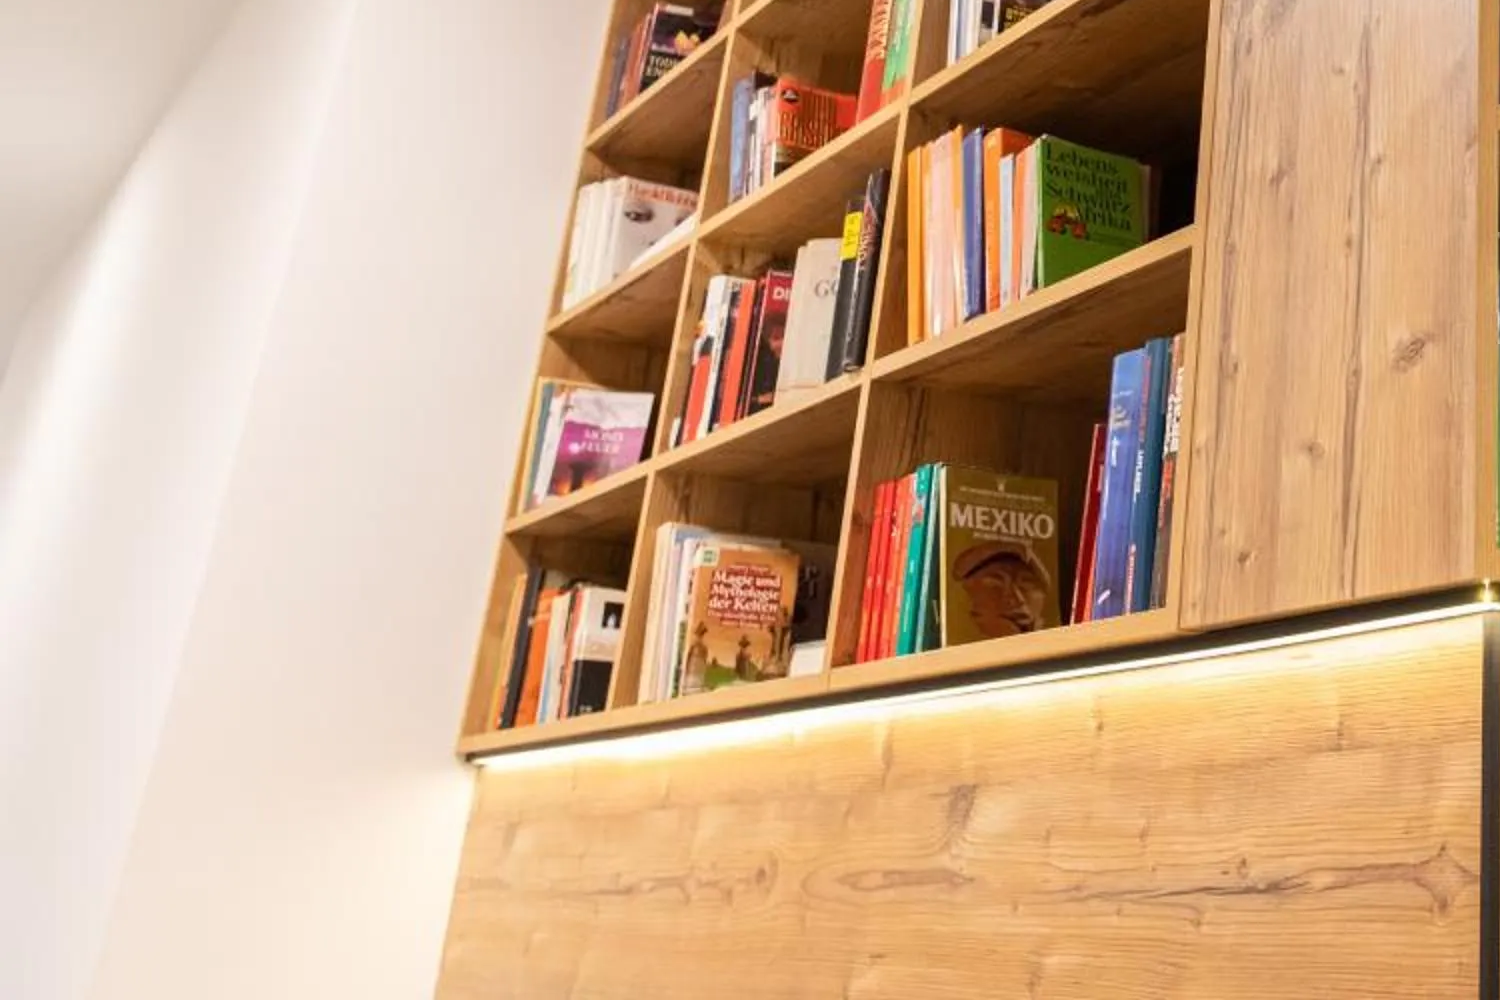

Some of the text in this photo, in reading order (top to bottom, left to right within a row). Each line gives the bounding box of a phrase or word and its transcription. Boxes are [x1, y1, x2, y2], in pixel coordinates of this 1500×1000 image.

[948, 501, 1056, 540] MEXIKO
[713, 569, 754, 589] Magie
[755, 573, 781, 587] und
[710, 583, 780, 604] Mythologie
[708, 595, 779, 614] der Kelten
